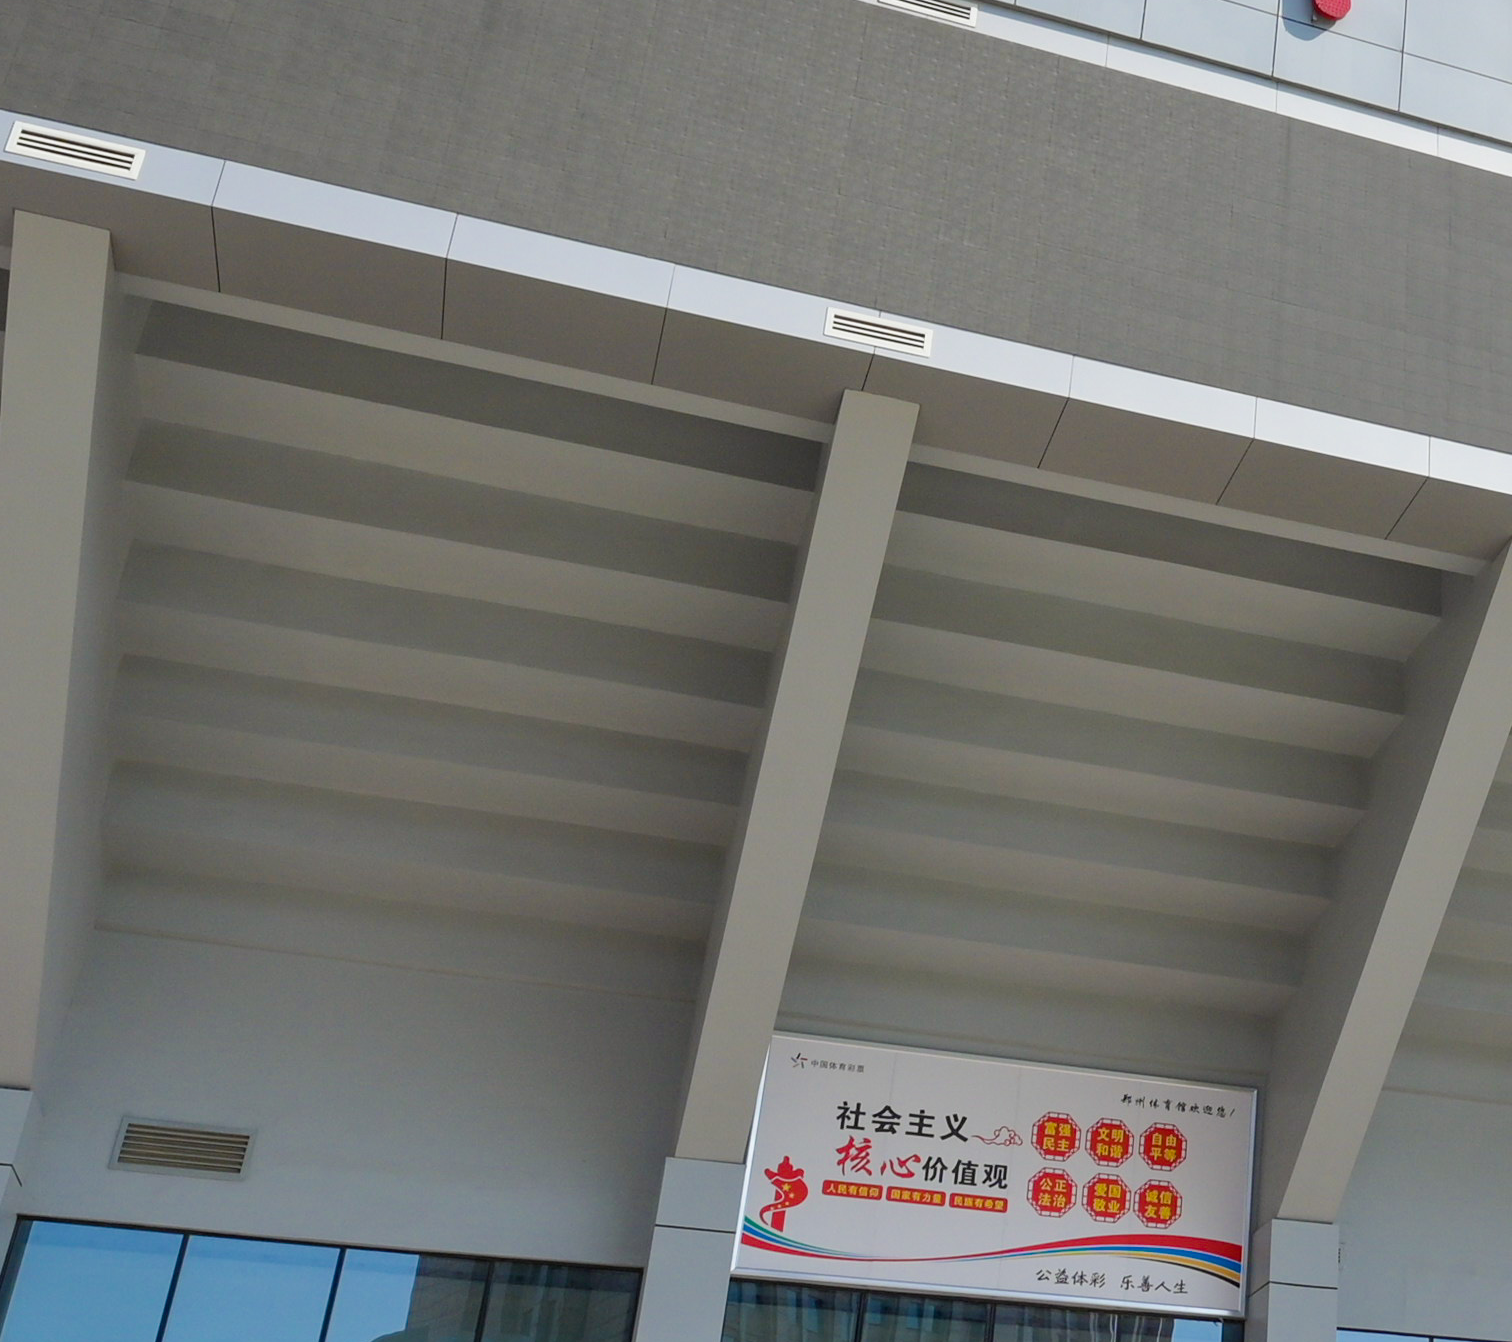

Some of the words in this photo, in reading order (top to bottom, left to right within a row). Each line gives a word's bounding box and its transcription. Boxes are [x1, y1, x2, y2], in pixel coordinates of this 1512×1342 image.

[810, 1058, 865, 1074] 中国体育彩票
[835, 1100, 970, 1144] 社会主义
[1044, 1121, 1072, 1137] 富强
[1097, 1127, 1125, 1143] 文明
[1151, 1132, 1178, 1148] 自由
[836, 1135, 1009, 1191] 核心价值观
[1042, 1136, 1070, 1153] 民主
[1096, 1143, 1124, 1159] 和谐
[1149, 1147, 1177, 1163] 平等
[826, 1183, 881, 1199] 人民有信仰
[890, 1190, 943, 1206] 国家有力量
[953, 1196, 1006, 1211] 民族有希望
[1039, 1177, 1068, 1193] 公正
[1094, 1183, 1123, 1198] 爱国
[1145, 1189, 1173, 1205] 诚信
[1038, 1192, 1067, 1208] 法治
[1093, 1196, 1122, 1214] 敬业
[1144, 1204, 1172, 1221] 友善
[1036, 1268, 1107, 1289] 公益体彩
[1120, 1274, 1189, 1295] 乐善人生
